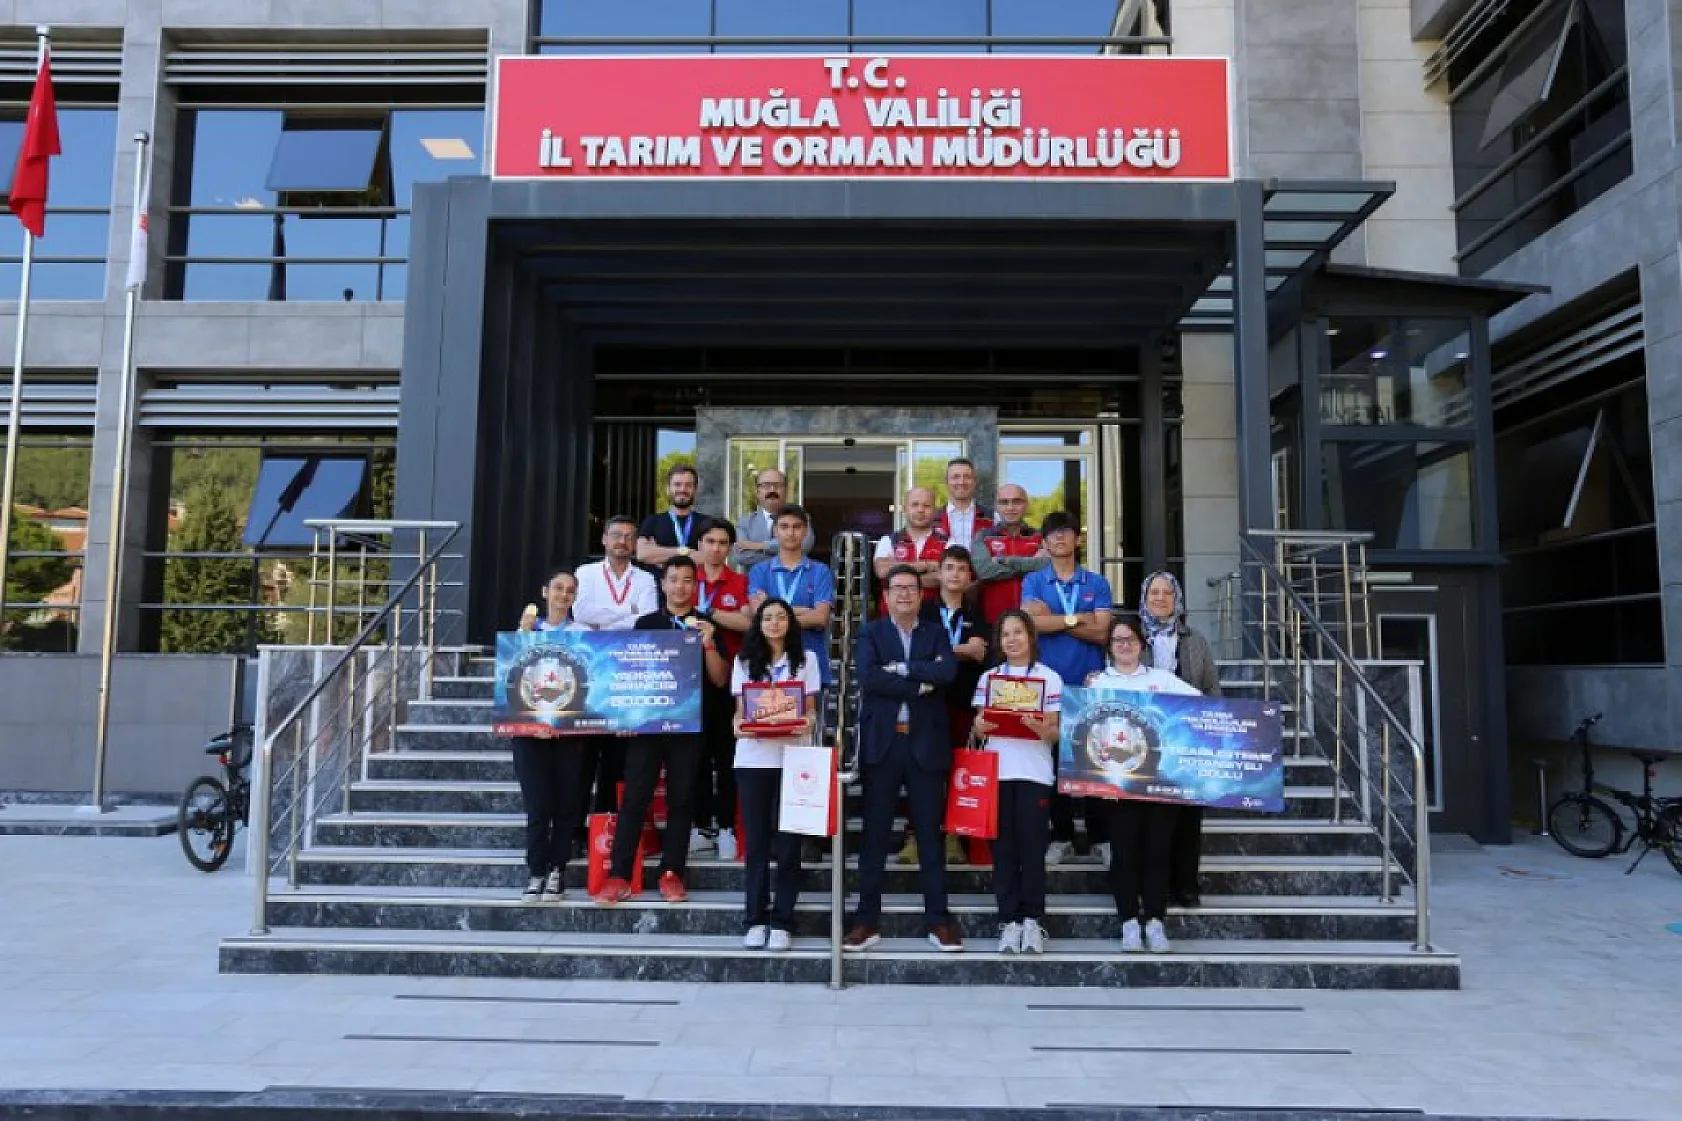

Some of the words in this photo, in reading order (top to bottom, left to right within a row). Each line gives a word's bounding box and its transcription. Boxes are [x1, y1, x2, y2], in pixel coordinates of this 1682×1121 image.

[824, 58, 907, 89] T.C.
[700, 88, 840, 128] MUĞLA
[864, 88, 1021, 128] VALİLİĞİ
[539, 128, 573, 168] İL
[580, 136, 700, 168] TARIM
[711, 136, 763, 168] VE
[772, 136, 924, 168] ORMAN
[932, 127, 1181, 168] MÜDÜRLÜĞÜ
